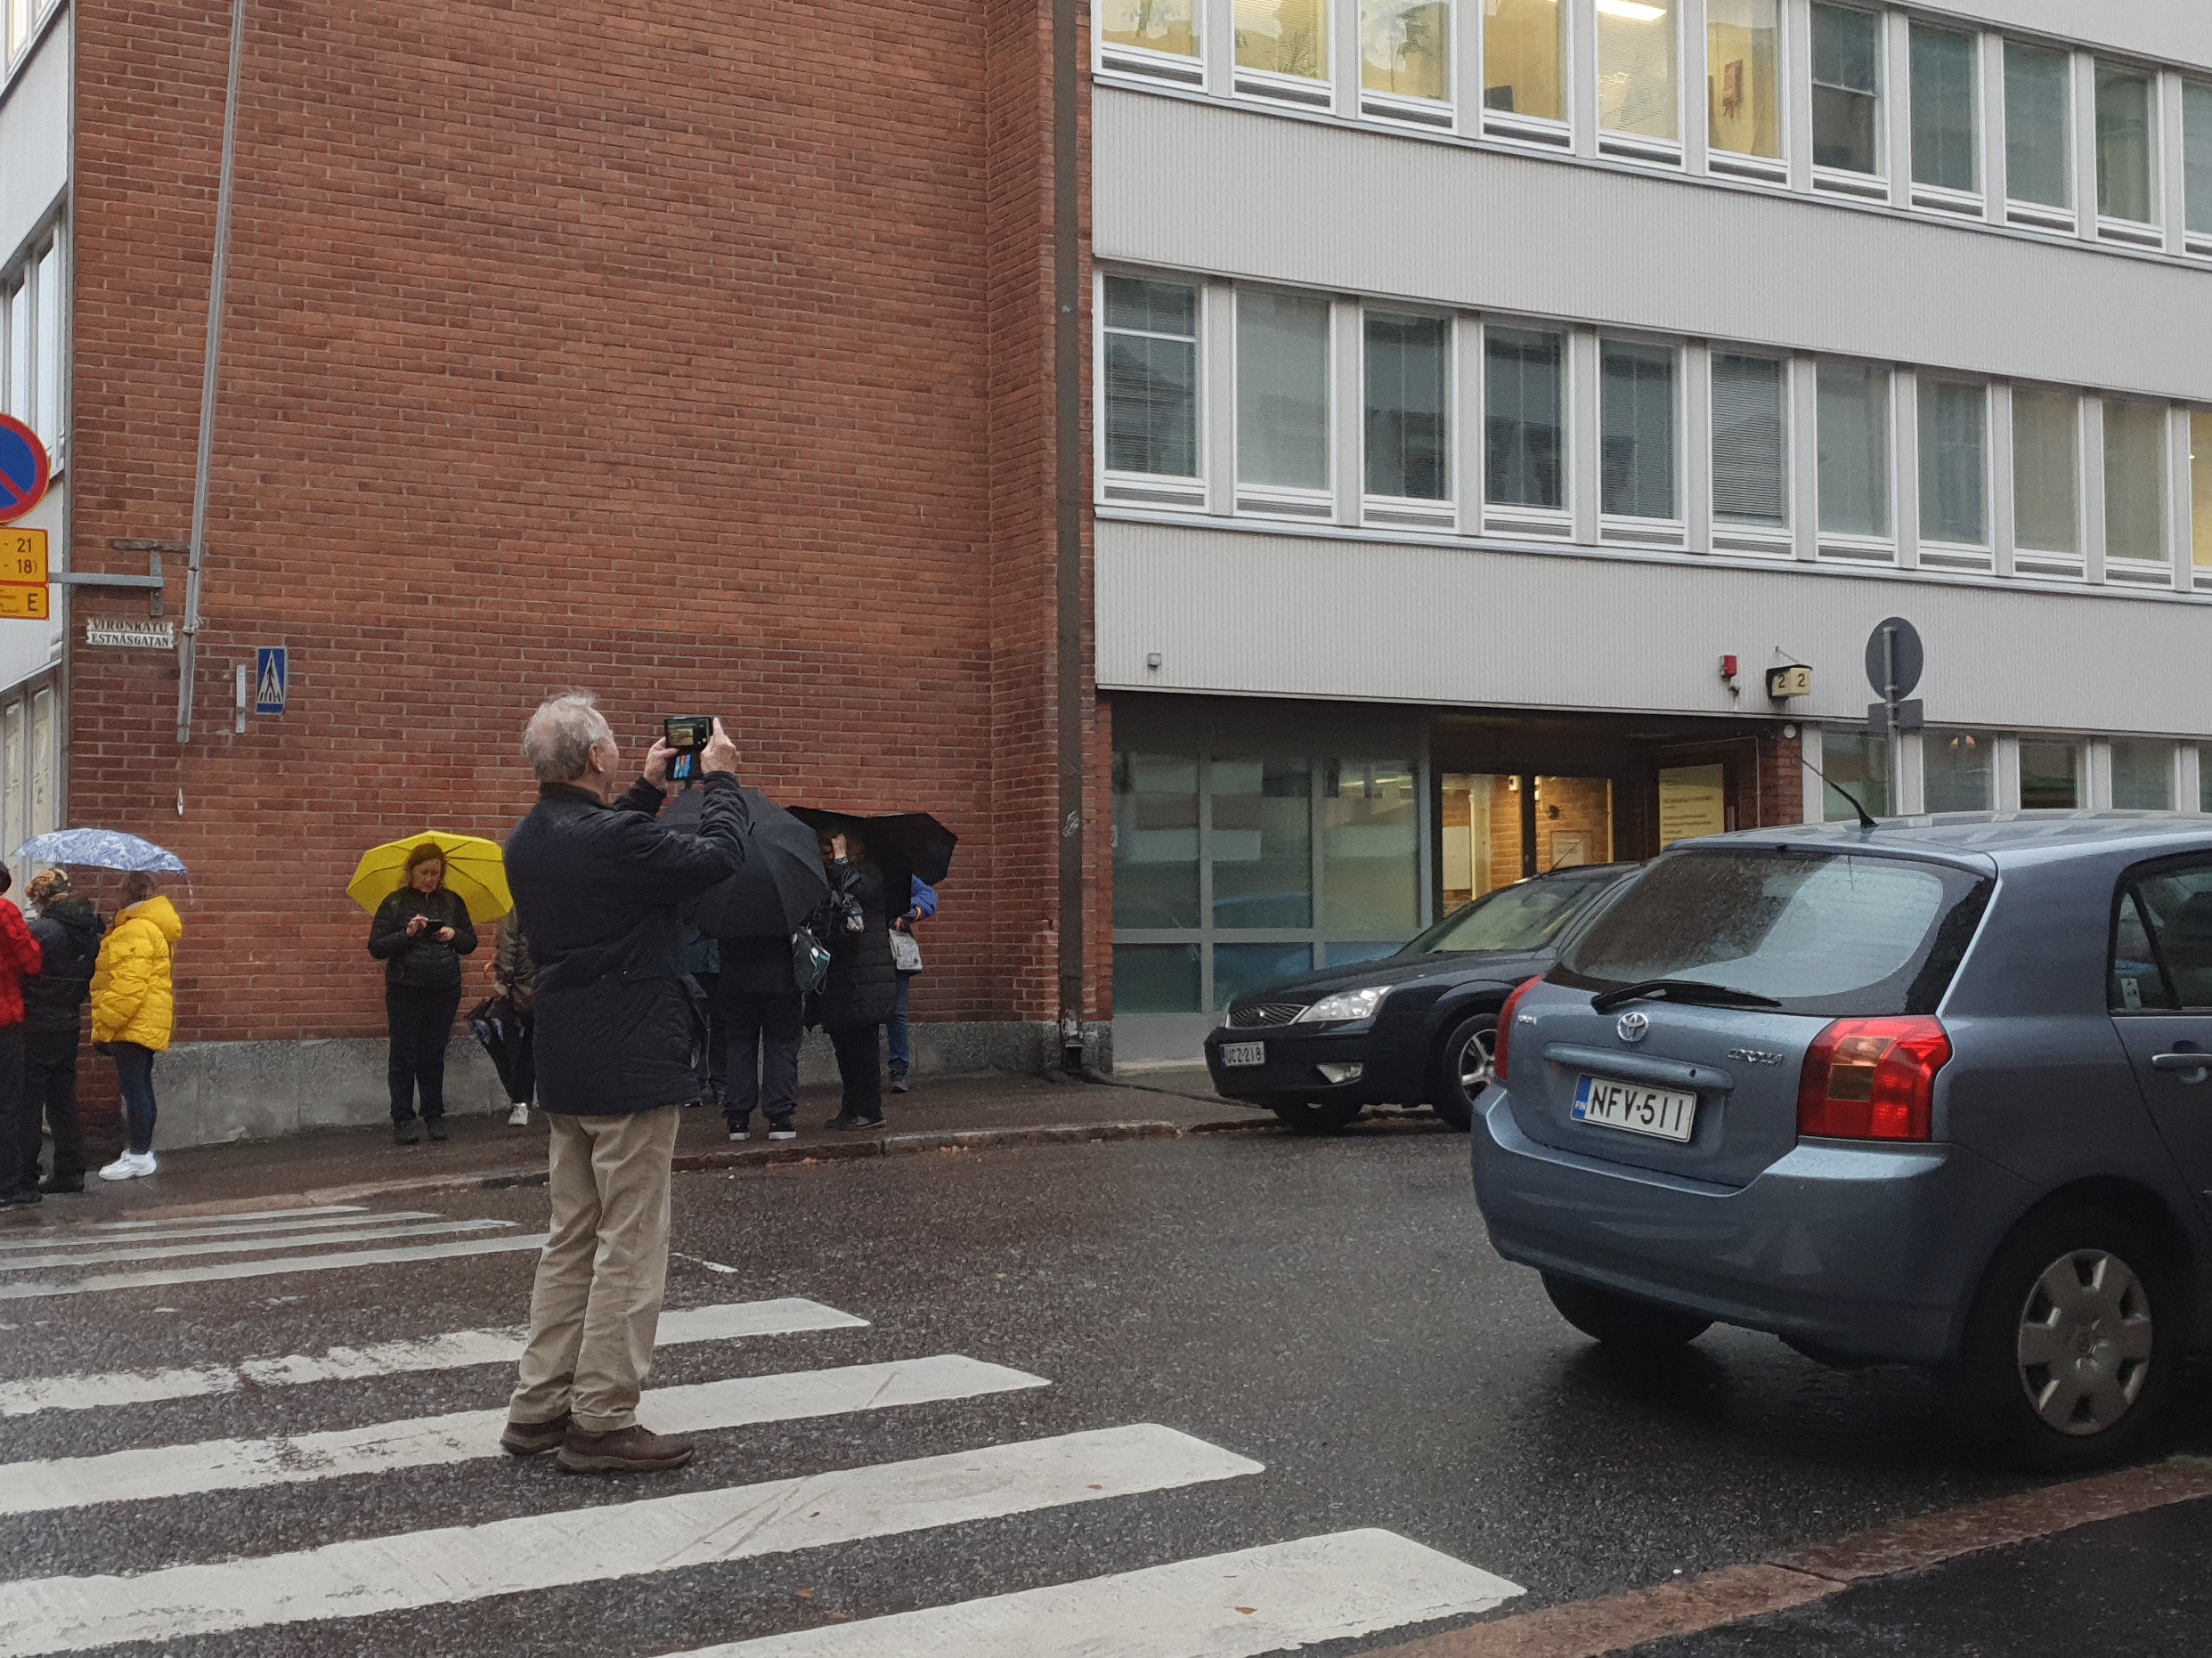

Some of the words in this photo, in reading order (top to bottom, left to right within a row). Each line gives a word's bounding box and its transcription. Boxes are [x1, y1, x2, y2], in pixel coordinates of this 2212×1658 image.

[17, 538, 32, 553] 21
[27, 593, 38, 612] E
[1590, 1085, 1684, 1132] NFV-511
